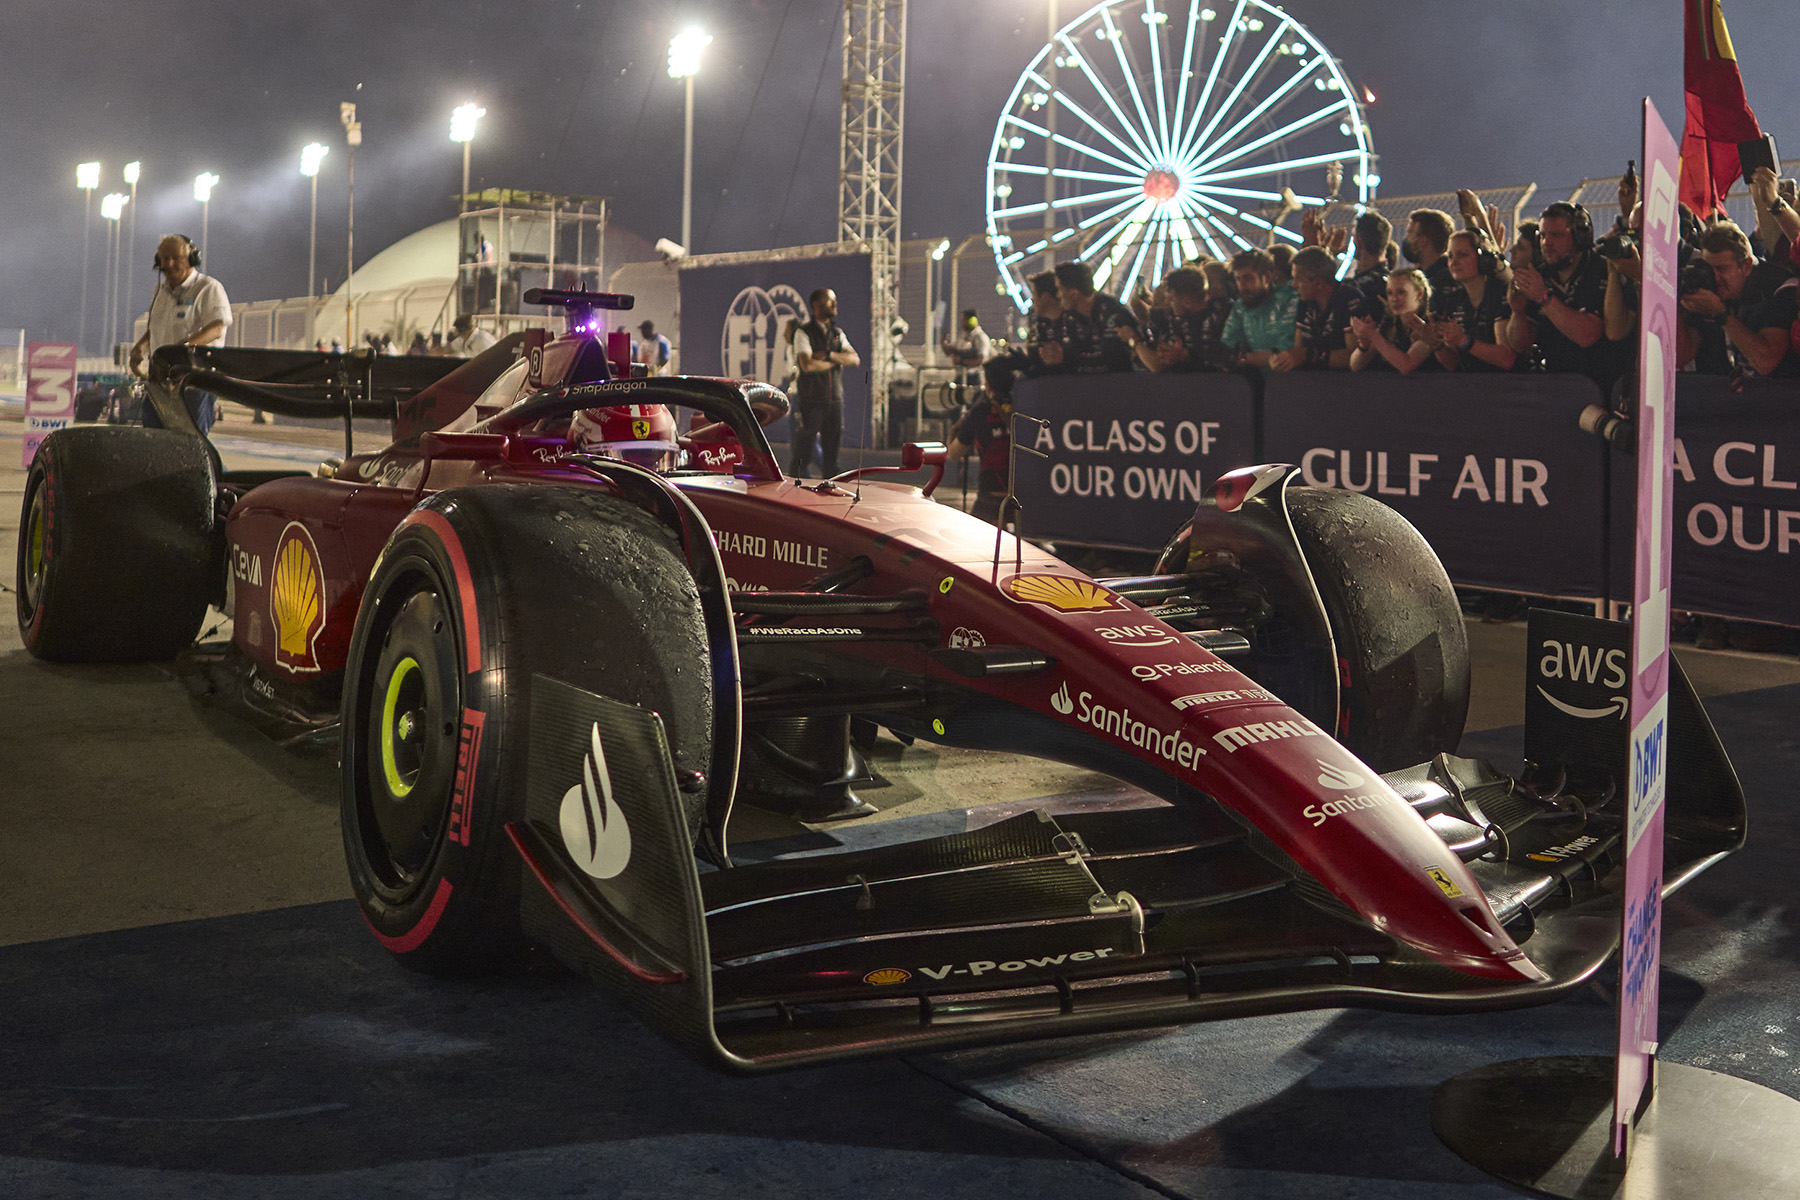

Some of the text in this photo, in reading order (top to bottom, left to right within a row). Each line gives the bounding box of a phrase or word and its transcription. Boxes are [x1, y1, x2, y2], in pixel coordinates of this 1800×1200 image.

[28, 367, 73, 414] 3
[572, 381, 647, 396] Snapdragon
[1034, 419, 1220, 455] A CLASS OF
[1050, 462, 1201, 502] OUR OWN
[1301, 447, 1549, 507] GULF AIR
[1686, 501, 1800, 554] OUR
[711, 529, 829, 569] HARD MILLE
[750, 627, 863, 636] #WeRaceAsOne
[1094, 624, 1166, 640] aws
[1154, 661, 1236, 678] Palanti
[1540, 639, 1627, 690] aws
[1170, 690, 1242, 711] PIRELLI
[1077, 691, 1208, 772] Santander
[1642, 718, 1664, 801] BWT
[918, 947, 1114, 981] V-Power
